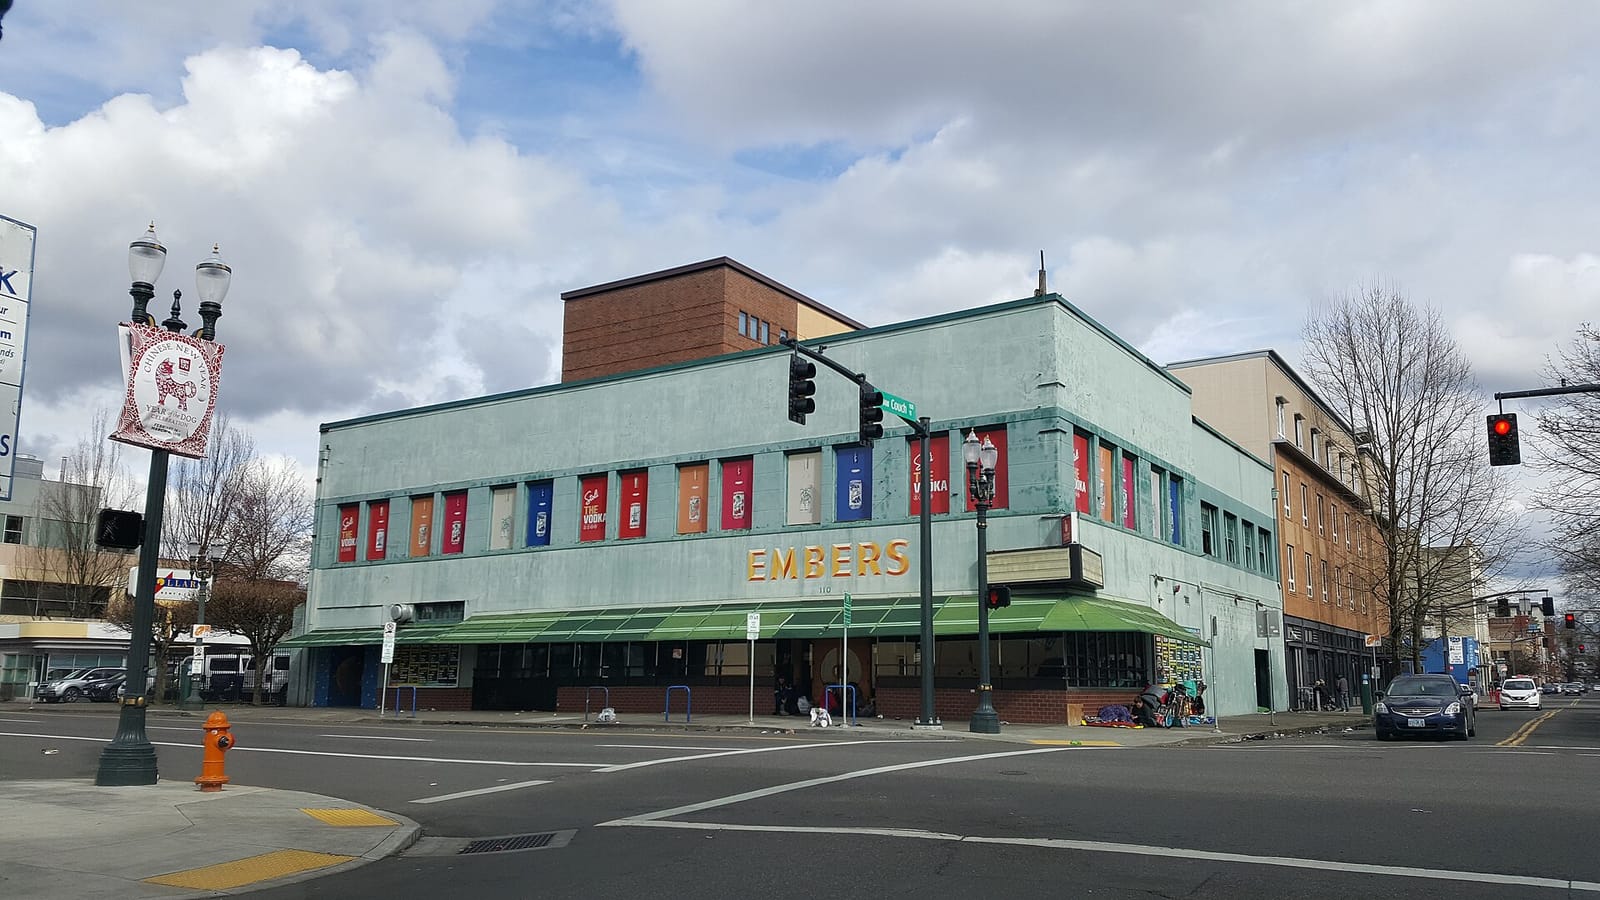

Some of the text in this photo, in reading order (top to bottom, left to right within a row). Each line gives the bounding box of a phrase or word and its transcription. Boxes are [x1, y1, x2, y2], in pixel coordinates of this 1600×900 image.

[144, 343, 173, 373] CHINESE
[176, 343, 200, 360] NEW
[890, 399, 907, 415] Couch
[180, 413, 197, 424] DOG
[583, 504, 599, 515] THE
[747, 538, 910, 581] EMBERS
[819, 586, 832, 594] 110
